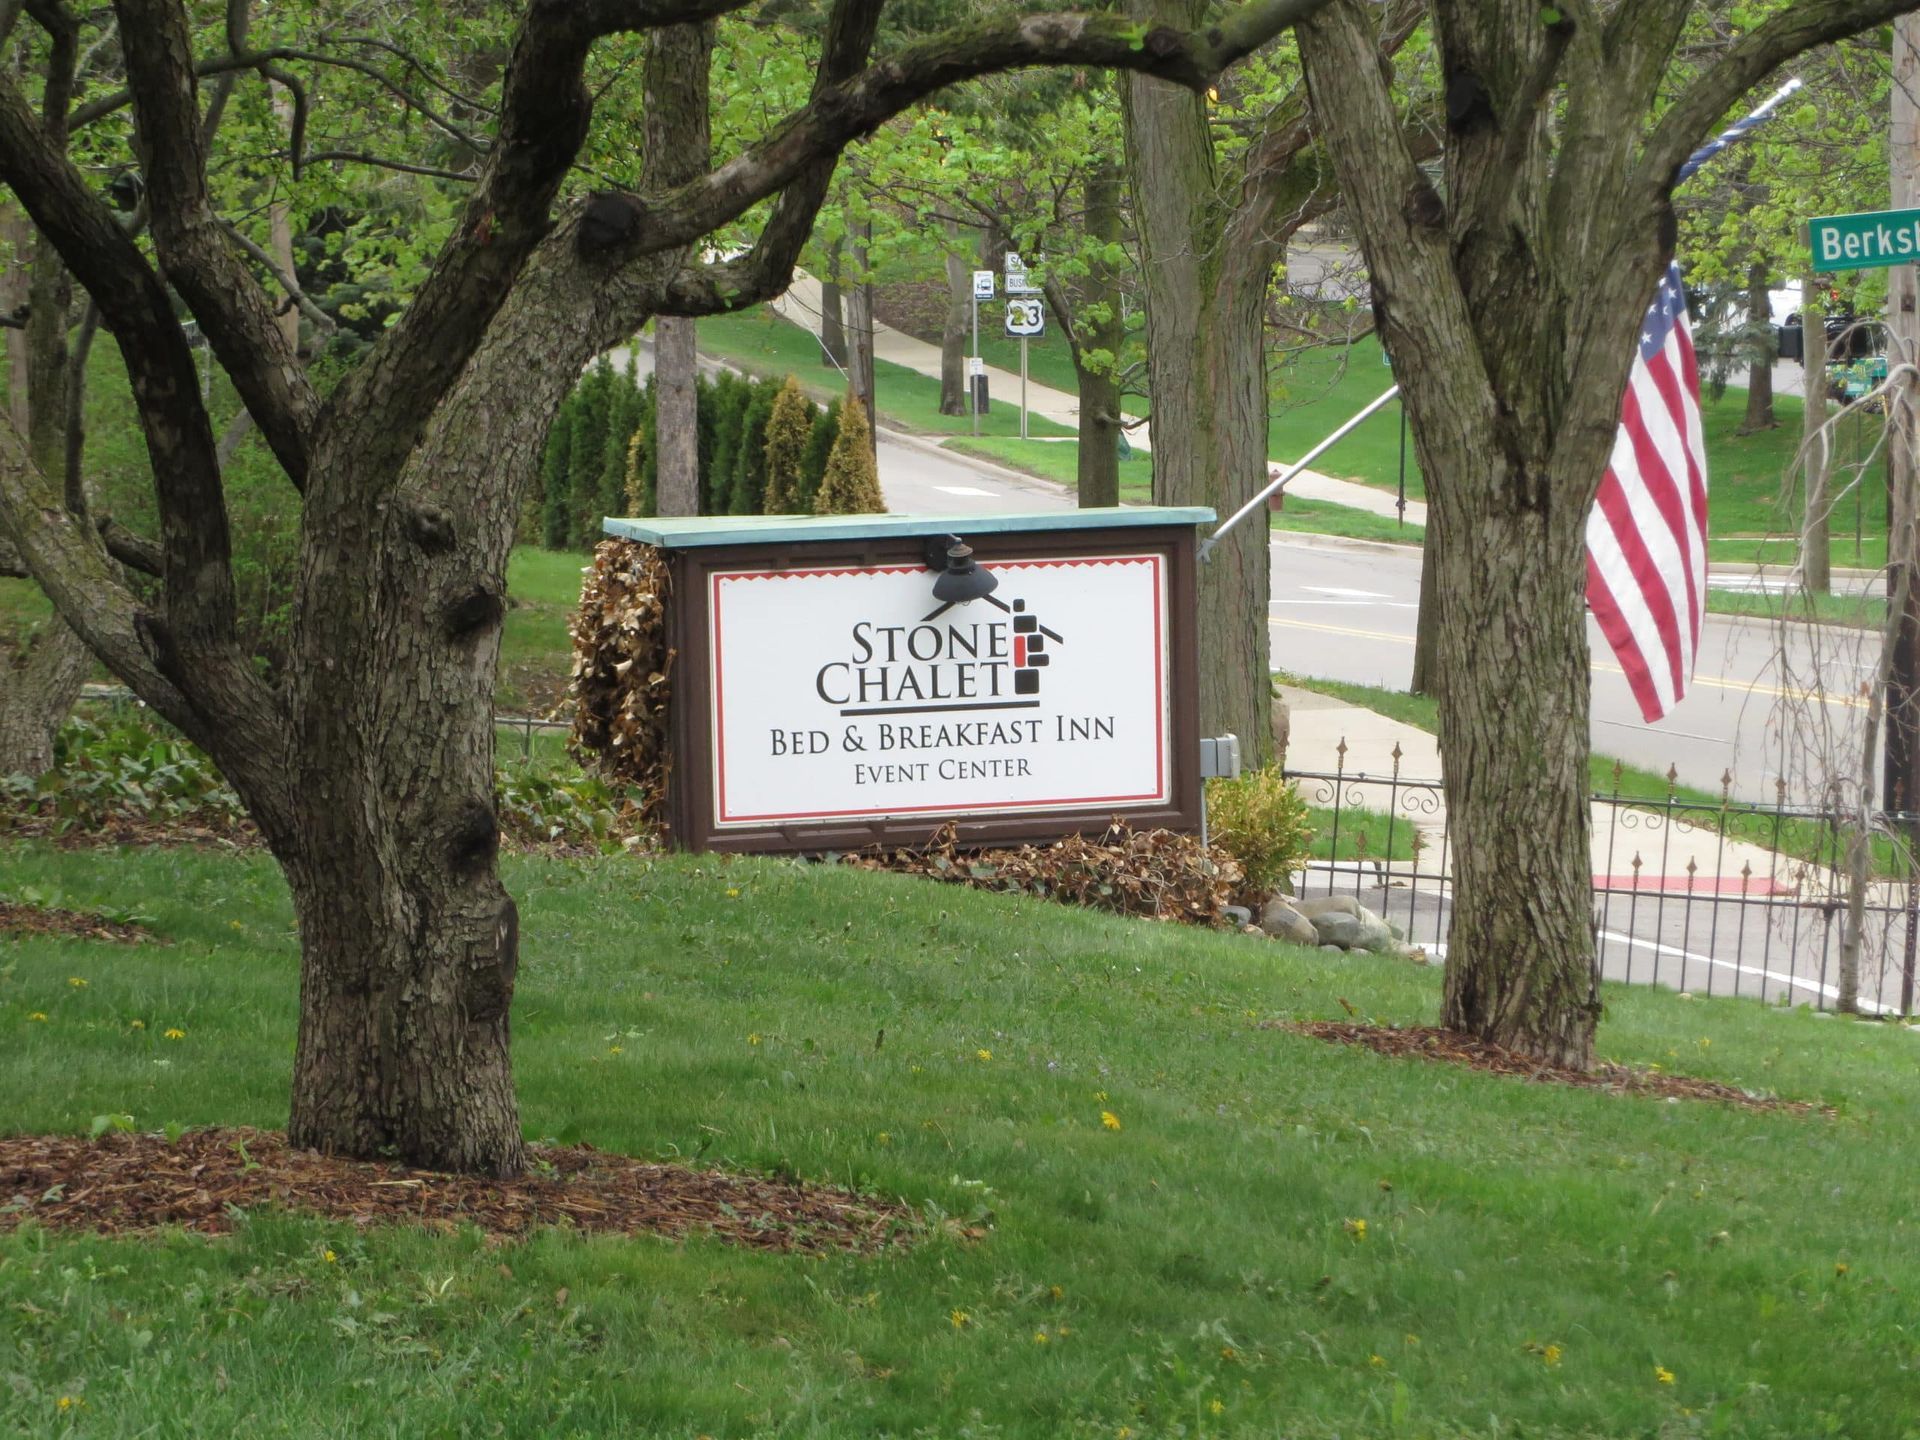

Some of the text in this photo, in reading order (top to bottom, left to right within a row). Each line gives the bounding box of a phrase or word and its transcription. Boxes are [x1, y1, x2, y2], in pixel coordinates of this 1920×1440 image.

[1011, 305, 1040, 327] 23
[852, 621, 1009, 665] STONE
[816, 661, 1009, 705] CHALET
[770, 714, 1115, 756] BED & BREAKFAST INN
[854, 758, 1033, 786] EVENT CENTER
